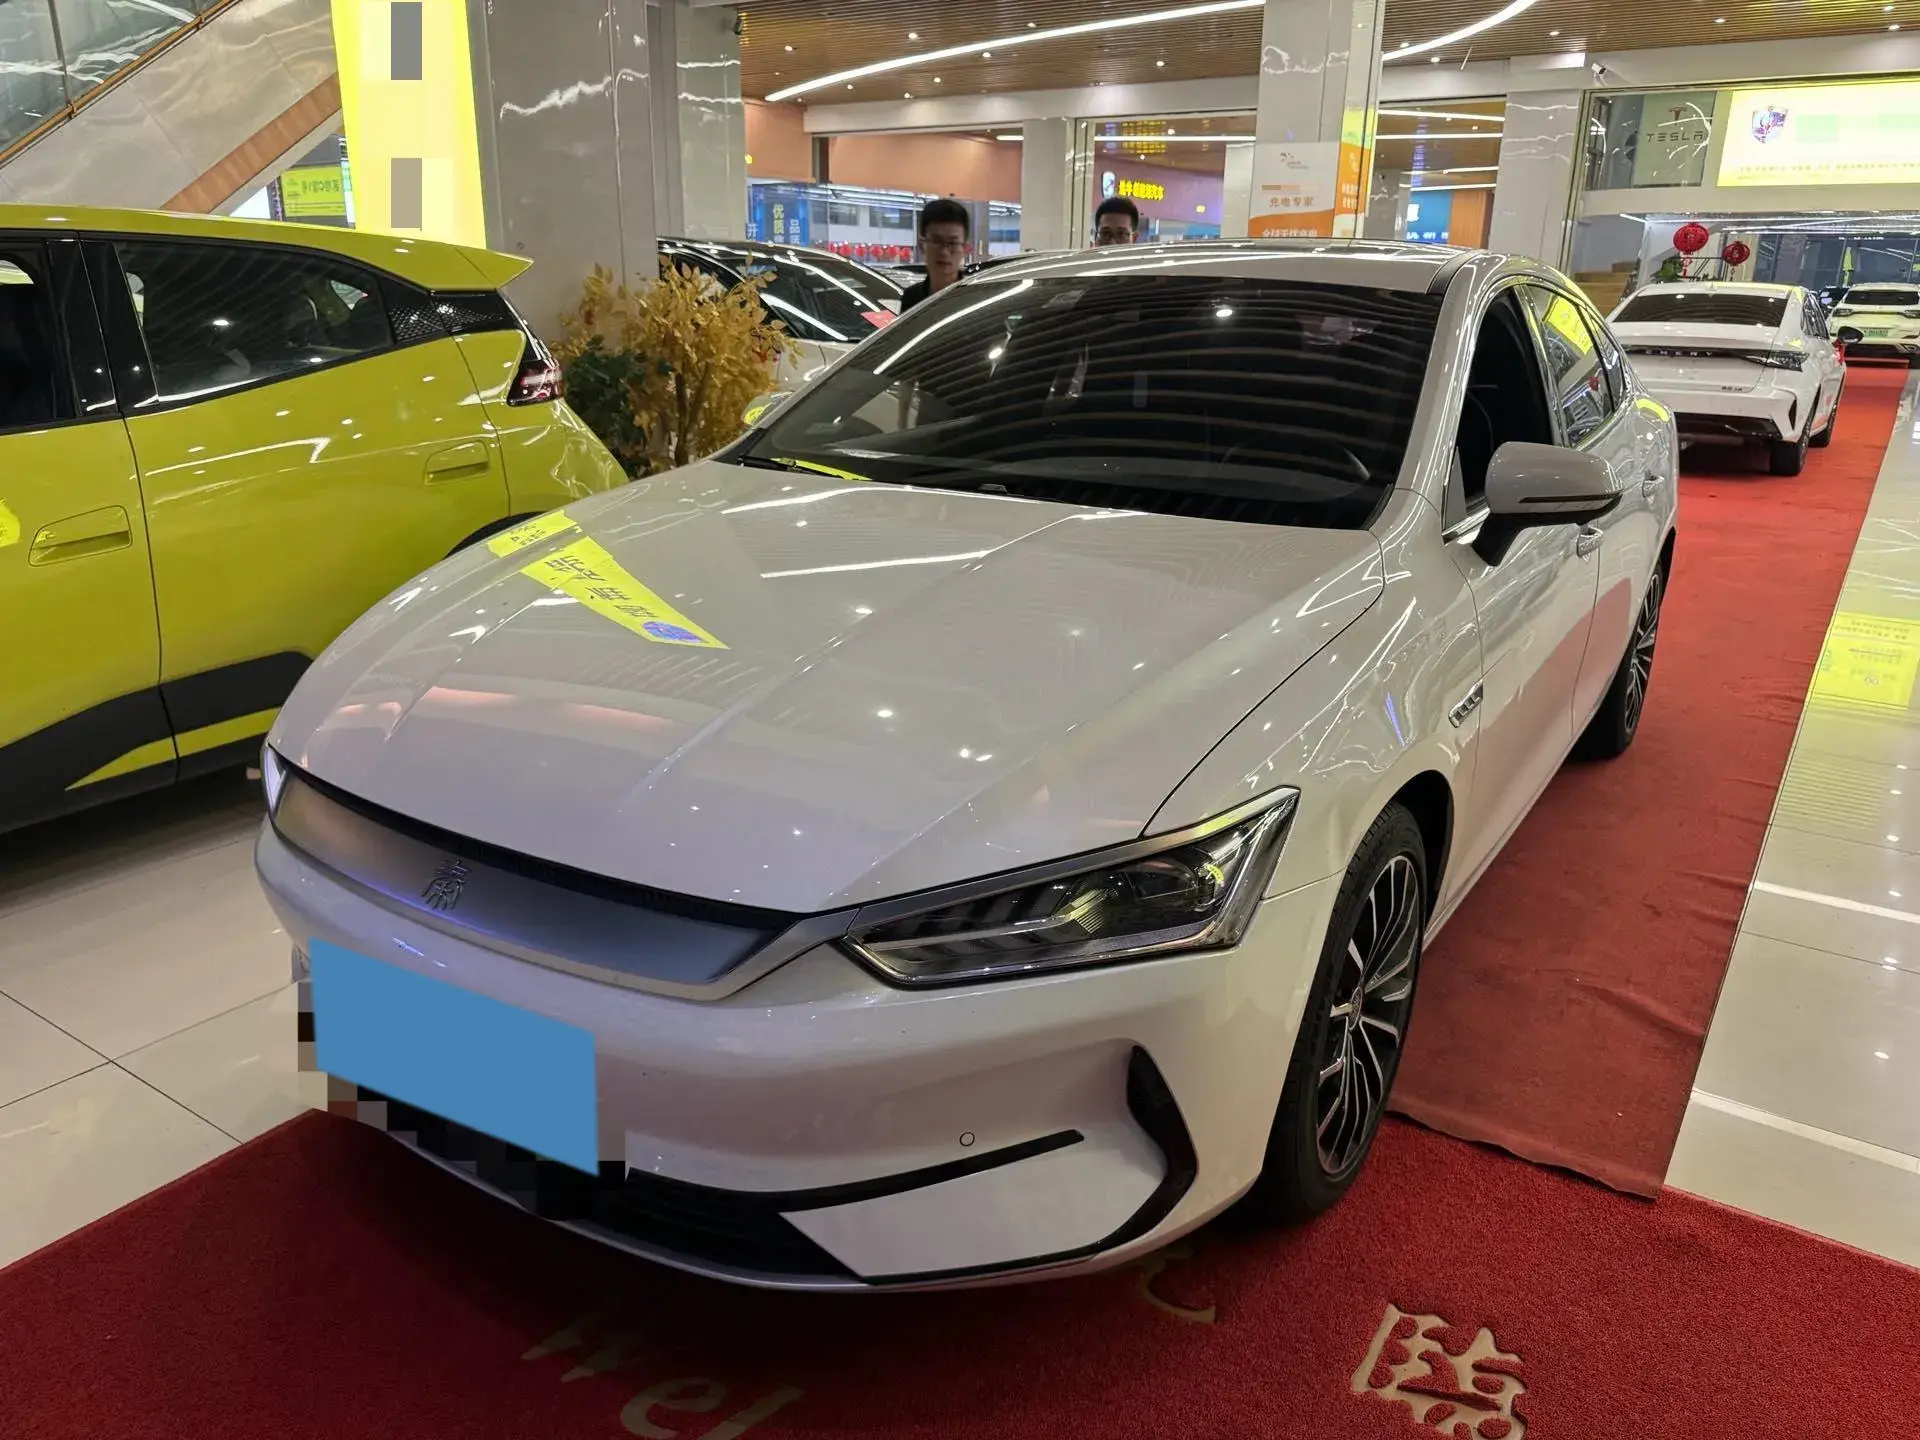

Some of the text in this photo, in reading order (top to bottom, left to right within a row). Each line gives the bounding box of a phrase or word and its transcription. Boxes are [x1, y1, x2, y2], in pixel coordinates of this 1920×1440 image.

[1646, 131, 1704, 143] TESLA
[1269, 196, 1315, 208] 充电专家
[1644, 349, 1713, 358] CHERY
